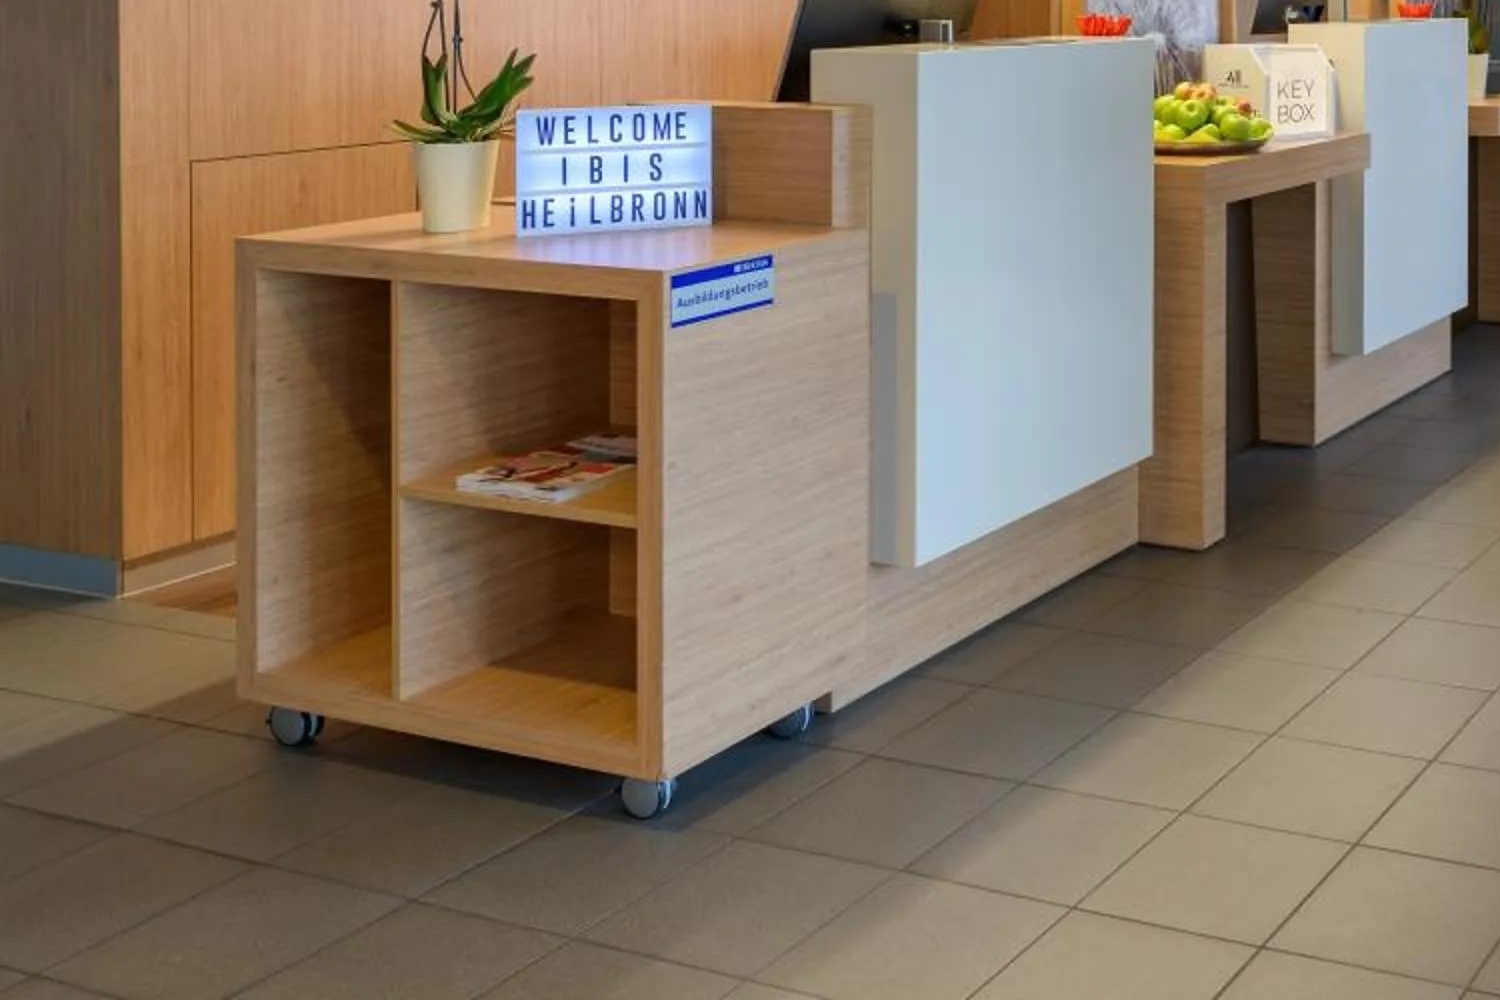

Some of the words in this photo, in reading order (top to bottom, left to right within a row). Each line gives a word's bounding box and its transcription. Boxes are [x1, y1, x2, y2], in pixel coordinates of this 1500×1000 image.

[1277, 79, 1315, 100] KEY
[1277, 103, 1315, 124] BOX
[536, 111, 688, 146] WELCOME
[561, 153, 664, 186] IBIS
[676, 279, 769, 308] Ausbildungsbetrieb
